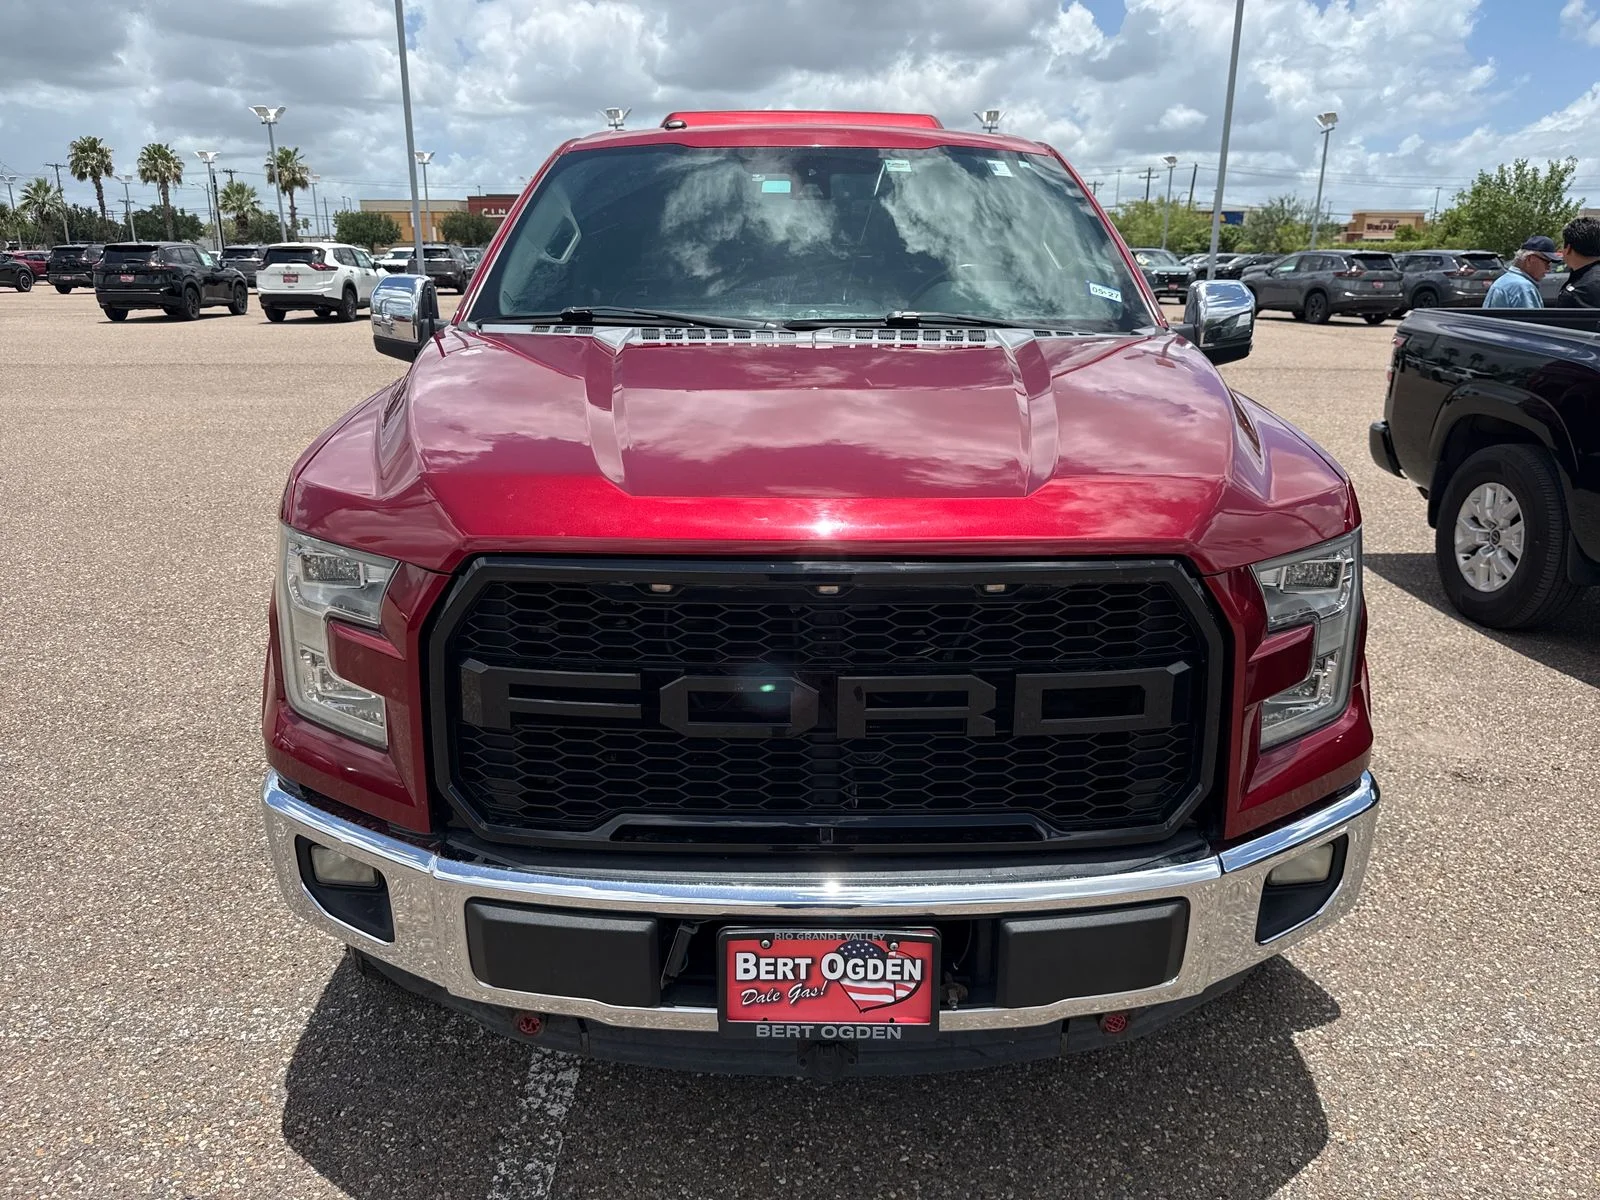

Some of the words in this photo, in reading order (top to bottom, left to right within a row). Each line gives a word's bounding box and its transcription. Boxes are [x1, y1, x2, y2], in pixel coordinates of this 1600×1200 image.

[482, 208, 507, 218] CIN
[459, 657, 1192, 739] FORD
[774, 932, 793, 940] RIO
[796, 932, 842, 941] GRANDE
[845, 932, 885, 941] VALLEY
[735, 952, 812, 981] BERT
[821, 952, 922, 981] OGDEN
[741, 988, 780, 1005] Dale
[788, 980, 828, 1005] Gas!
[756, 1024, 814, 1038] BERT
[821, 1025, 901, 1040] OGDEN
